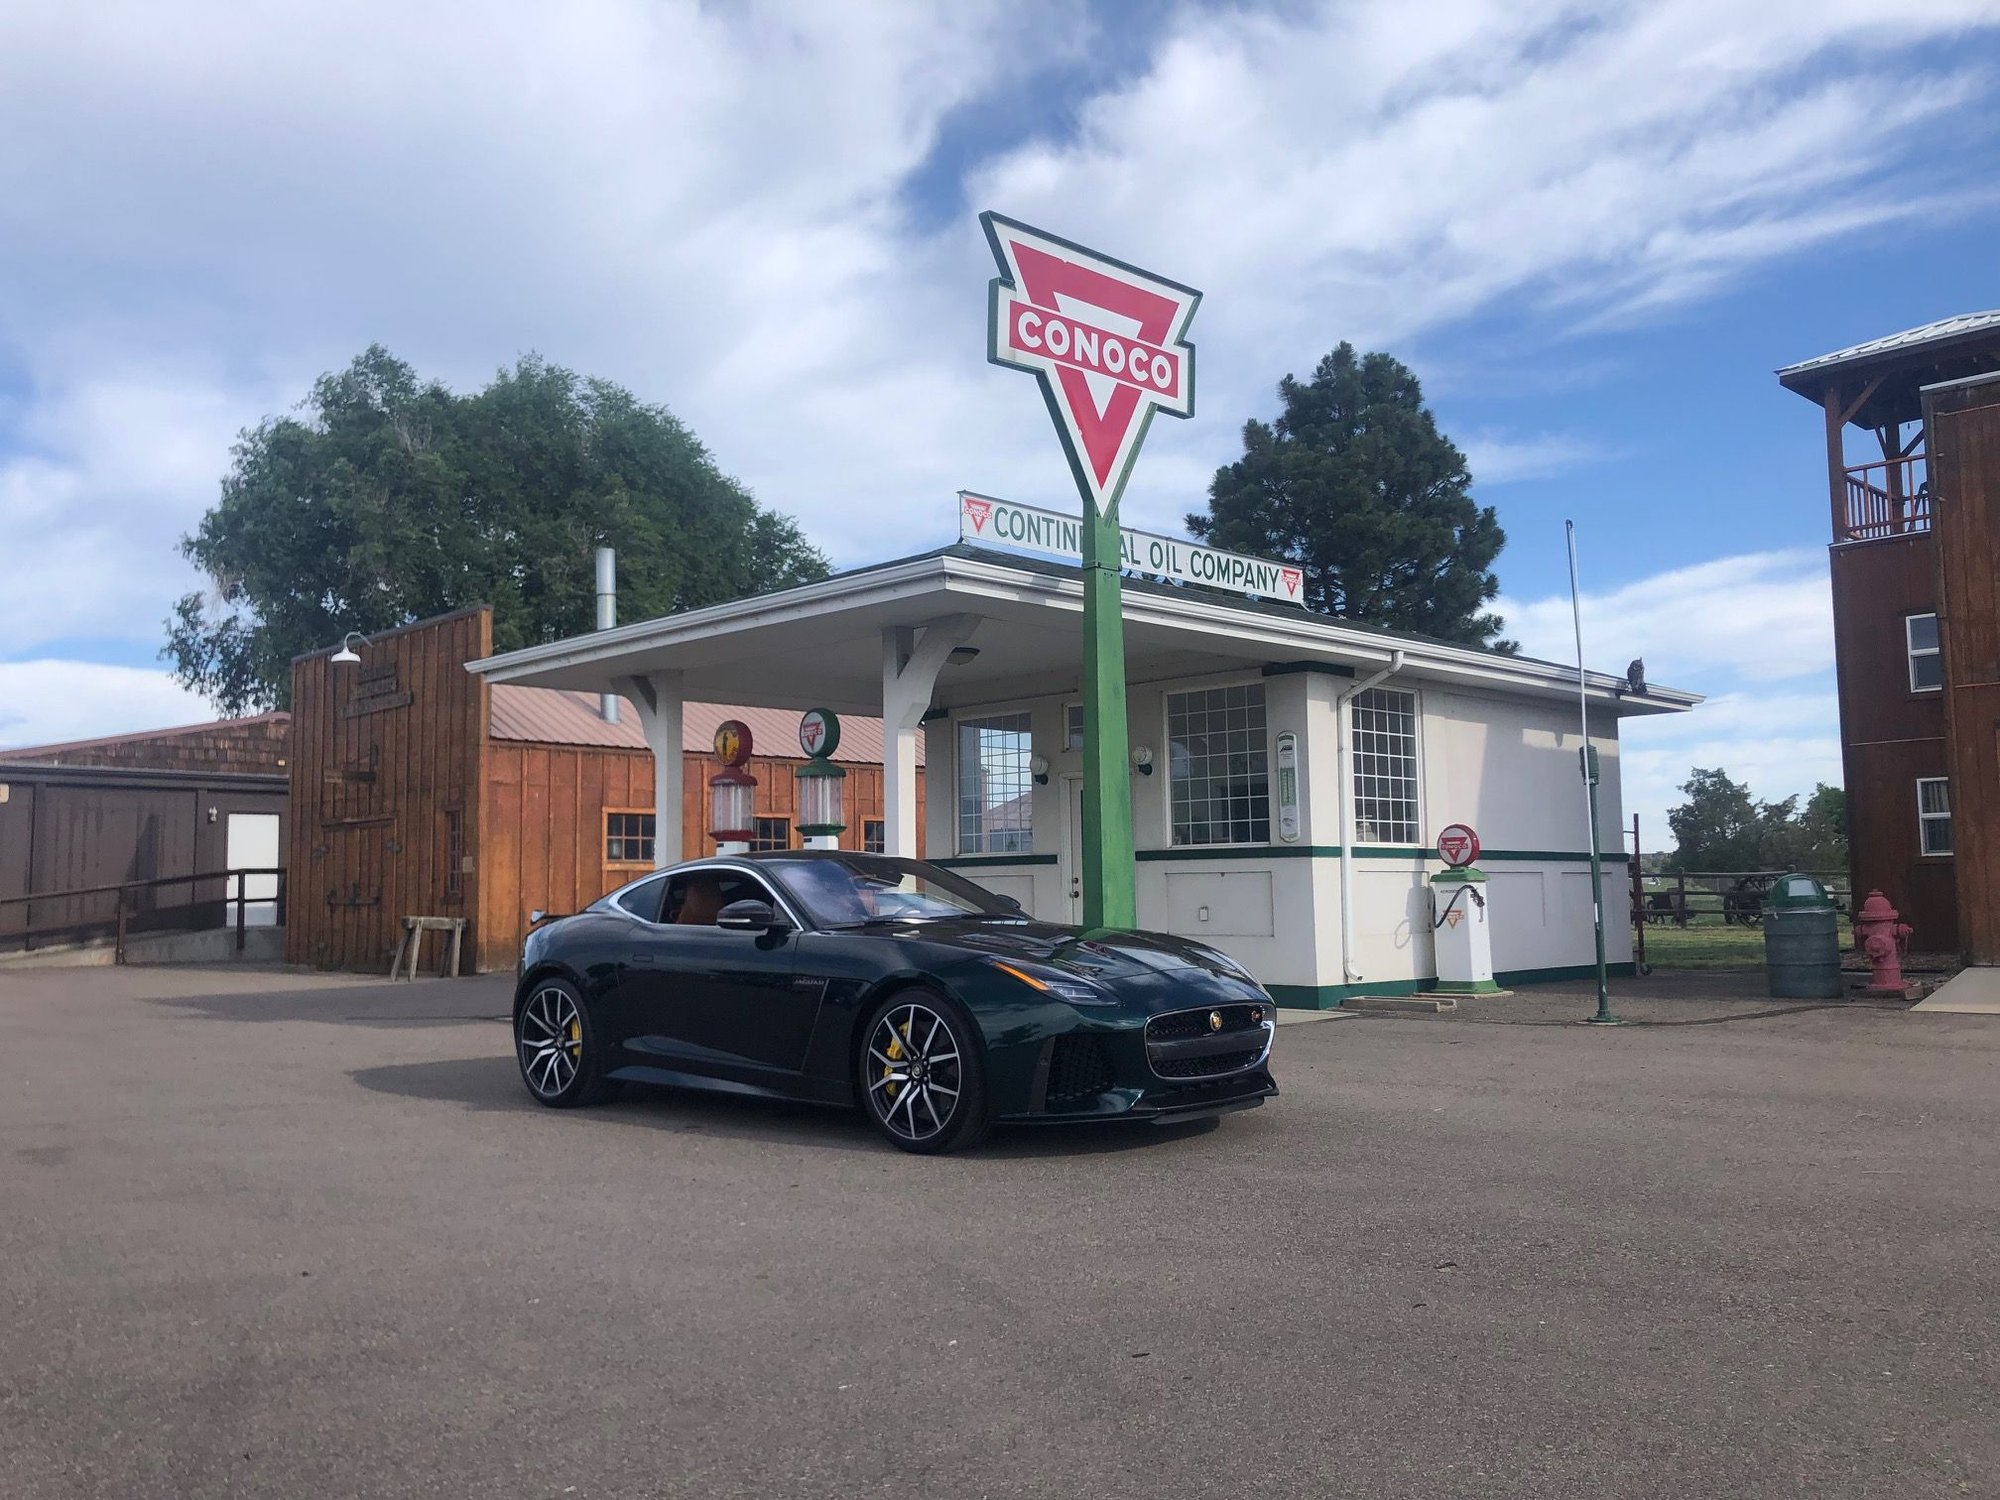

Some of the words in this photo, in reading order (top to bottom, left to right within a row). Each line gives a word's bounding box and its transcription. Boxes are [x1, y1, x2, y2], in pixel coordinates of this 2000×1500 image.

[1017, 311, 1172, 389] CONOCO
[964, 507, 992, 519] CONOCO
[994, 506, 1141, 566] CONTINAL
[1150, 541, 1182, 574] OIL
[1190, 550, 1279, 593] COMPANY
